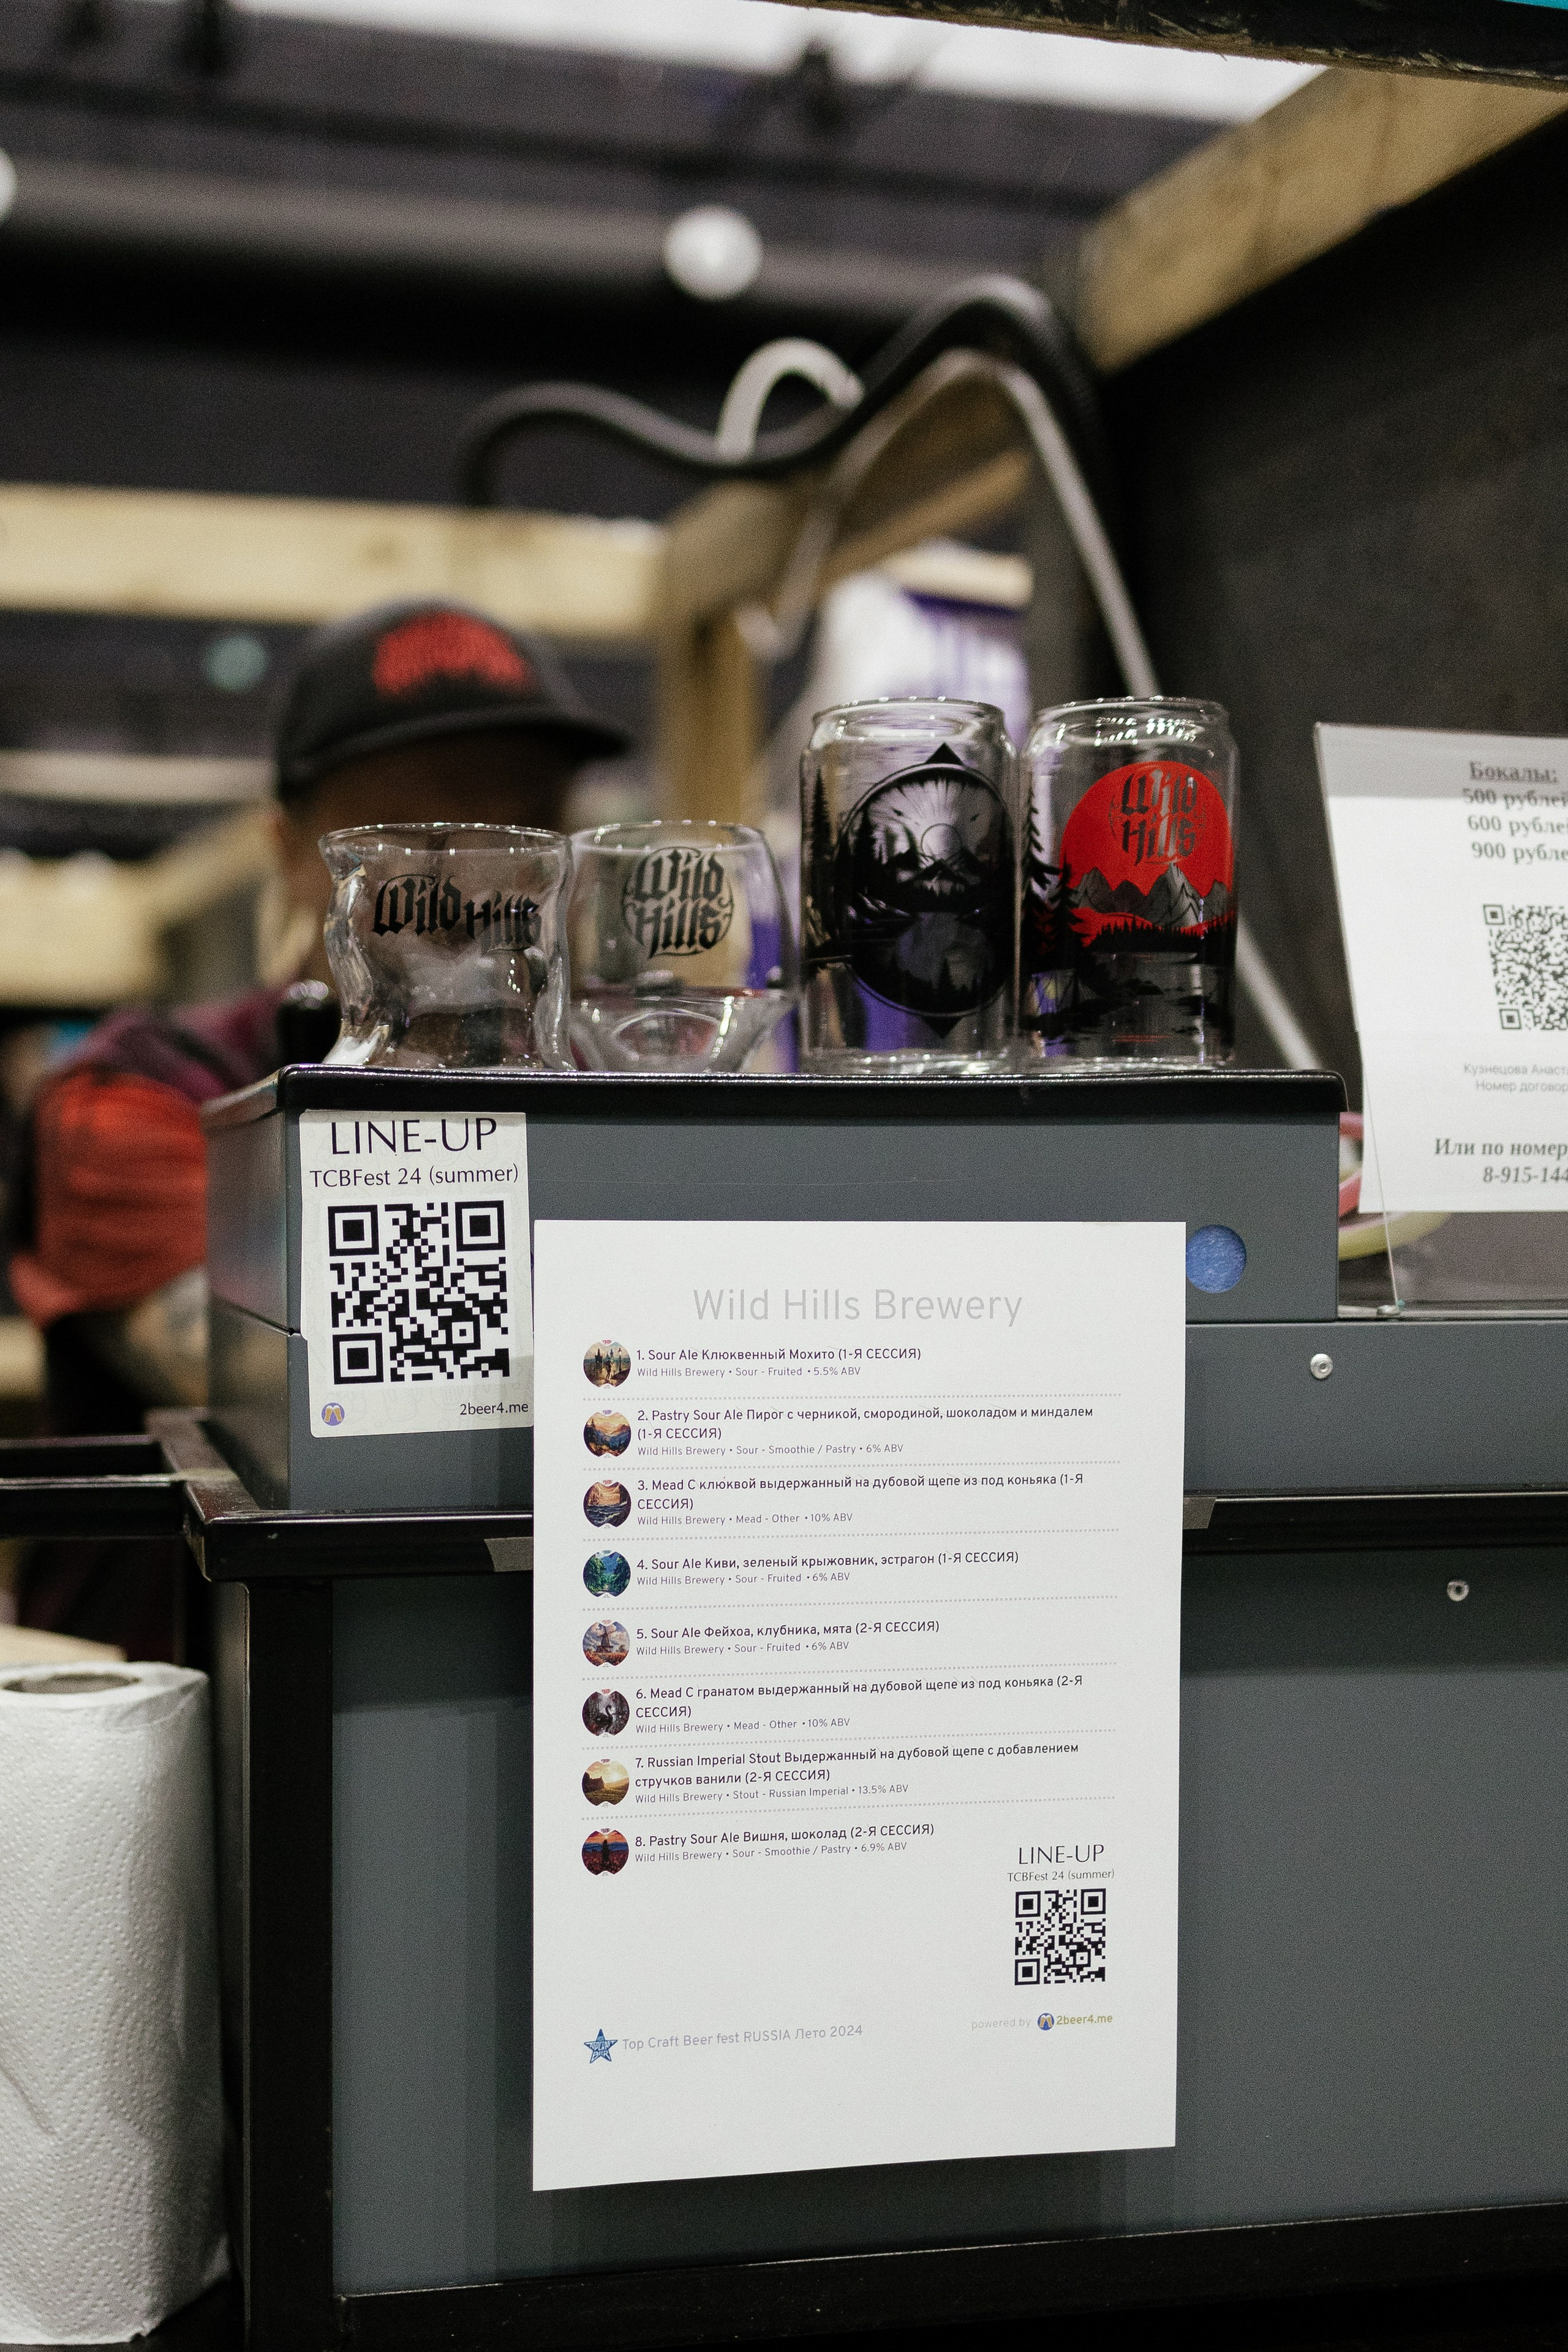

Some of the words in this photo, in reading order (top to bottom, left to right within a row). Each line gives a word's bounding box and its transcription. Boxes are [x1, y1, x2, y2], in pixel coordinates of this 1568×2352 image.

[1462, 788, 1497, 804] 500
[1468, 815, 1502, 831] 600
[1471, 842, 1506, 859] 900
[631, 848, 726, 901] Wild
[372, 874, 463, 937] Wild
[1464, 1063, 1528, 1076] Кузнецова
[1476, 1080, 1517, 1092] Номер
[331, 1118, 497, 1155] LINE-UP
[1434, 1138, 1475, 1156] Или
[1482, 1142, 1504, 1156] по
[310, 1167, 390, 1188] TCBFest
[398, 1167, 421, 1185] 24
[429, 1163, 519, 1185] (summer)
[693, 1289, 768, 1320] Wild
[785, 1289, 860, 1320] Hills
[875, 1289, 1022, 1327] Brewery
[637, 1350, 644, 1360] 1.
[649, 1349, 676, 1360] Sour
[679, 1349, 698, 1359] Ale
[702, 1349, 785, 1359] Клюквенный
[790, 1349, 834, 1359] Мохито
[839, 1348, 862, 1360] (1-Я
[866, 1348, 921, 1360] СЕССИЯ)
[638, 1368, 657, 1376] Wild
[685, 1368, 725, 1378] Brewery
[736, 1367, 758, 1376] Sour
[769, 1367, 802, 1376] Fruited
[814, 1366, 838, 1376] 5.5%
[841, 1366, 861, 1376] ABV
[460, 1402, 529, 1415] 2beer4.me
[638, 1409, 648, 1420] 2.
[652, 1410, 689, 1423] Pastry
[693, 1409, 720, 1420] Sour
[724, 1409, 743, 1419] Ale
[747, 1409, 783, 1422] Пирог
[797, 1408, 860, 1421] черникой,
[864, 1406, 943, 1420] смородиной,
[946, 1409, 1017, 1419] шоколадом
[1031, 1408, 1093, 1418] миндалем
[638, 1428, 662, 1440] (1-Я
[666, 1427, 722, 1439] СЕССИЯ)
[638, 1480, 647, 1490] 3.
[652, 1479, 684, 1490] Mead
[699, 1478, 756, 1489] клюквой
[760, 1476, 851, 1490] выдержанный
[873, 1476, 924, 1489] дубовой
[929, 1477, 960, 1487] щепе
[981, 1477, 1004, 1487] под
[1008, 1476, 1056, 1485] коньяка
[1060, 1473, 1083, 1485] (1-Я
[638, 1498, 693, 1510] СЕССИЯ)
[685, 1515, 725, 1525] Brewery
[736, 1514, 761, 1523] Mead
[772, 1513, 799, 1523] Other
[811, 1513, 830, 1522] 10%
[637, 1559, 647, 1569] 4.
[652, 1559, 679, 1569] Sour
[682, 1558, 701, 1569] Ale
[706, 1558, 739, 1569] Киви,
[743, 1556, 797, 1567] зеленый
[802, 1557, 878, 1568] крыжовник,
[881, 1556, 934, 1566] эстрагон
[938, 1553, 961, 1564] (1-Я
[965, 1551, 1018, 1563] СЕССИЯ)
[637, 1628, 647, 1638] 5.
[651, 1628, 679, 1638] Sour
[682, 1627, 701, 1637] Ale
[704, 1626, 753, 1637] Фейхоа,
[757, 1624, 820, 1637] клубника,
[824, 1625, 851, 1634] мята
[856, 1622, 881, 1635] (2-Я
[886, 1621, 939, 1632] СЕССИЯ)
[636, 1688, 646, 1698] 6.
[650, 1687, 682, 1698] Mead
[698, 1687, 754, 1699] гранатом
[758, 1681, 849, 1696] выдержанный
[853, 1683, 867, 1692] на
[870, 1679, 922, 1694] дубовой
[926, 1681, 957, 1691] щепе
[961, 1680, 974, 1689] из
[979, 1679, 1001, 1689] под
[1005, 1678, 1053, 1687] коньяка
[1057, 1675, 1082, 1687] (2-Я
[636, 1705, 691, 1717] СЕССИЯ)
[635, 1757, 643, 1768] 7.
[648, 1755, 693, 1767] Russian
[698, 1753, 745, 1767] Imperial
[749, 1752, 780, 1763] Stout
[785, 1748, 876, 1763] Выдержанный
[897, 1746, 948, 1760] дубовой
[952, 1747, 984, 1757] щепе
[997, 1744, 1078, 1756] добавлением
[635, 1776, 692, 1789] стручков
[696, 1775, 741, 1784] ванили
[745, 1771, 771, 1784] (2-Я
[775, 1769, 830, 1781] СЕССИЯ)
[636, 1794, 655, 1803] Wild
[684, 1793, 722, 1801] Brewery
[733, 1790, 758, 1799] Stout
[769, 1789, 806, 1797] Russian
[810, 1787, 848, 1797] Imperial
[859, 1784, 886, 1795] 13.5%
[889, 1784, 909, 1793] ABV
[635, 1836, 646, 1847] 8.
[650, 1834, 687, 1847] Pastry
[691, 1833, 717, 1844] Sour
[721, 1831, 739, 1842] Ale
[744, 1831, 788, 1842] Вишня,
[791, 1830, 846, 1839] шоколад
[851, 1826, 876, 1838] (2-Я
[880, 1823, 934, 1836] СЕССИЯ)
[1019, 1844, 1104, 1864] LINE-UP
[1008, 1871, 1048, 1882] TCBFest
[1052, 1871, 1064, 1880] 24
[1068, 1868, 1114, 1879] (summer)
[972, 2018, 1016, 2031] powered
[1019, 2018, 1031, 2028] by
[1057, 2015, 1114, 2026] 2beer4.me
[622, 2038, 644, 2052] Top
[648, 2035, 679, 2049] Craft
[684, 2034, 714, 2047] Beer
[716, 2032, 740, 2045] fest
[744, 2029, 791, 2043] RUSSIA
[795, 2028, 826, 2040] Лето
[830, 2024, 863, 2038] 2024
